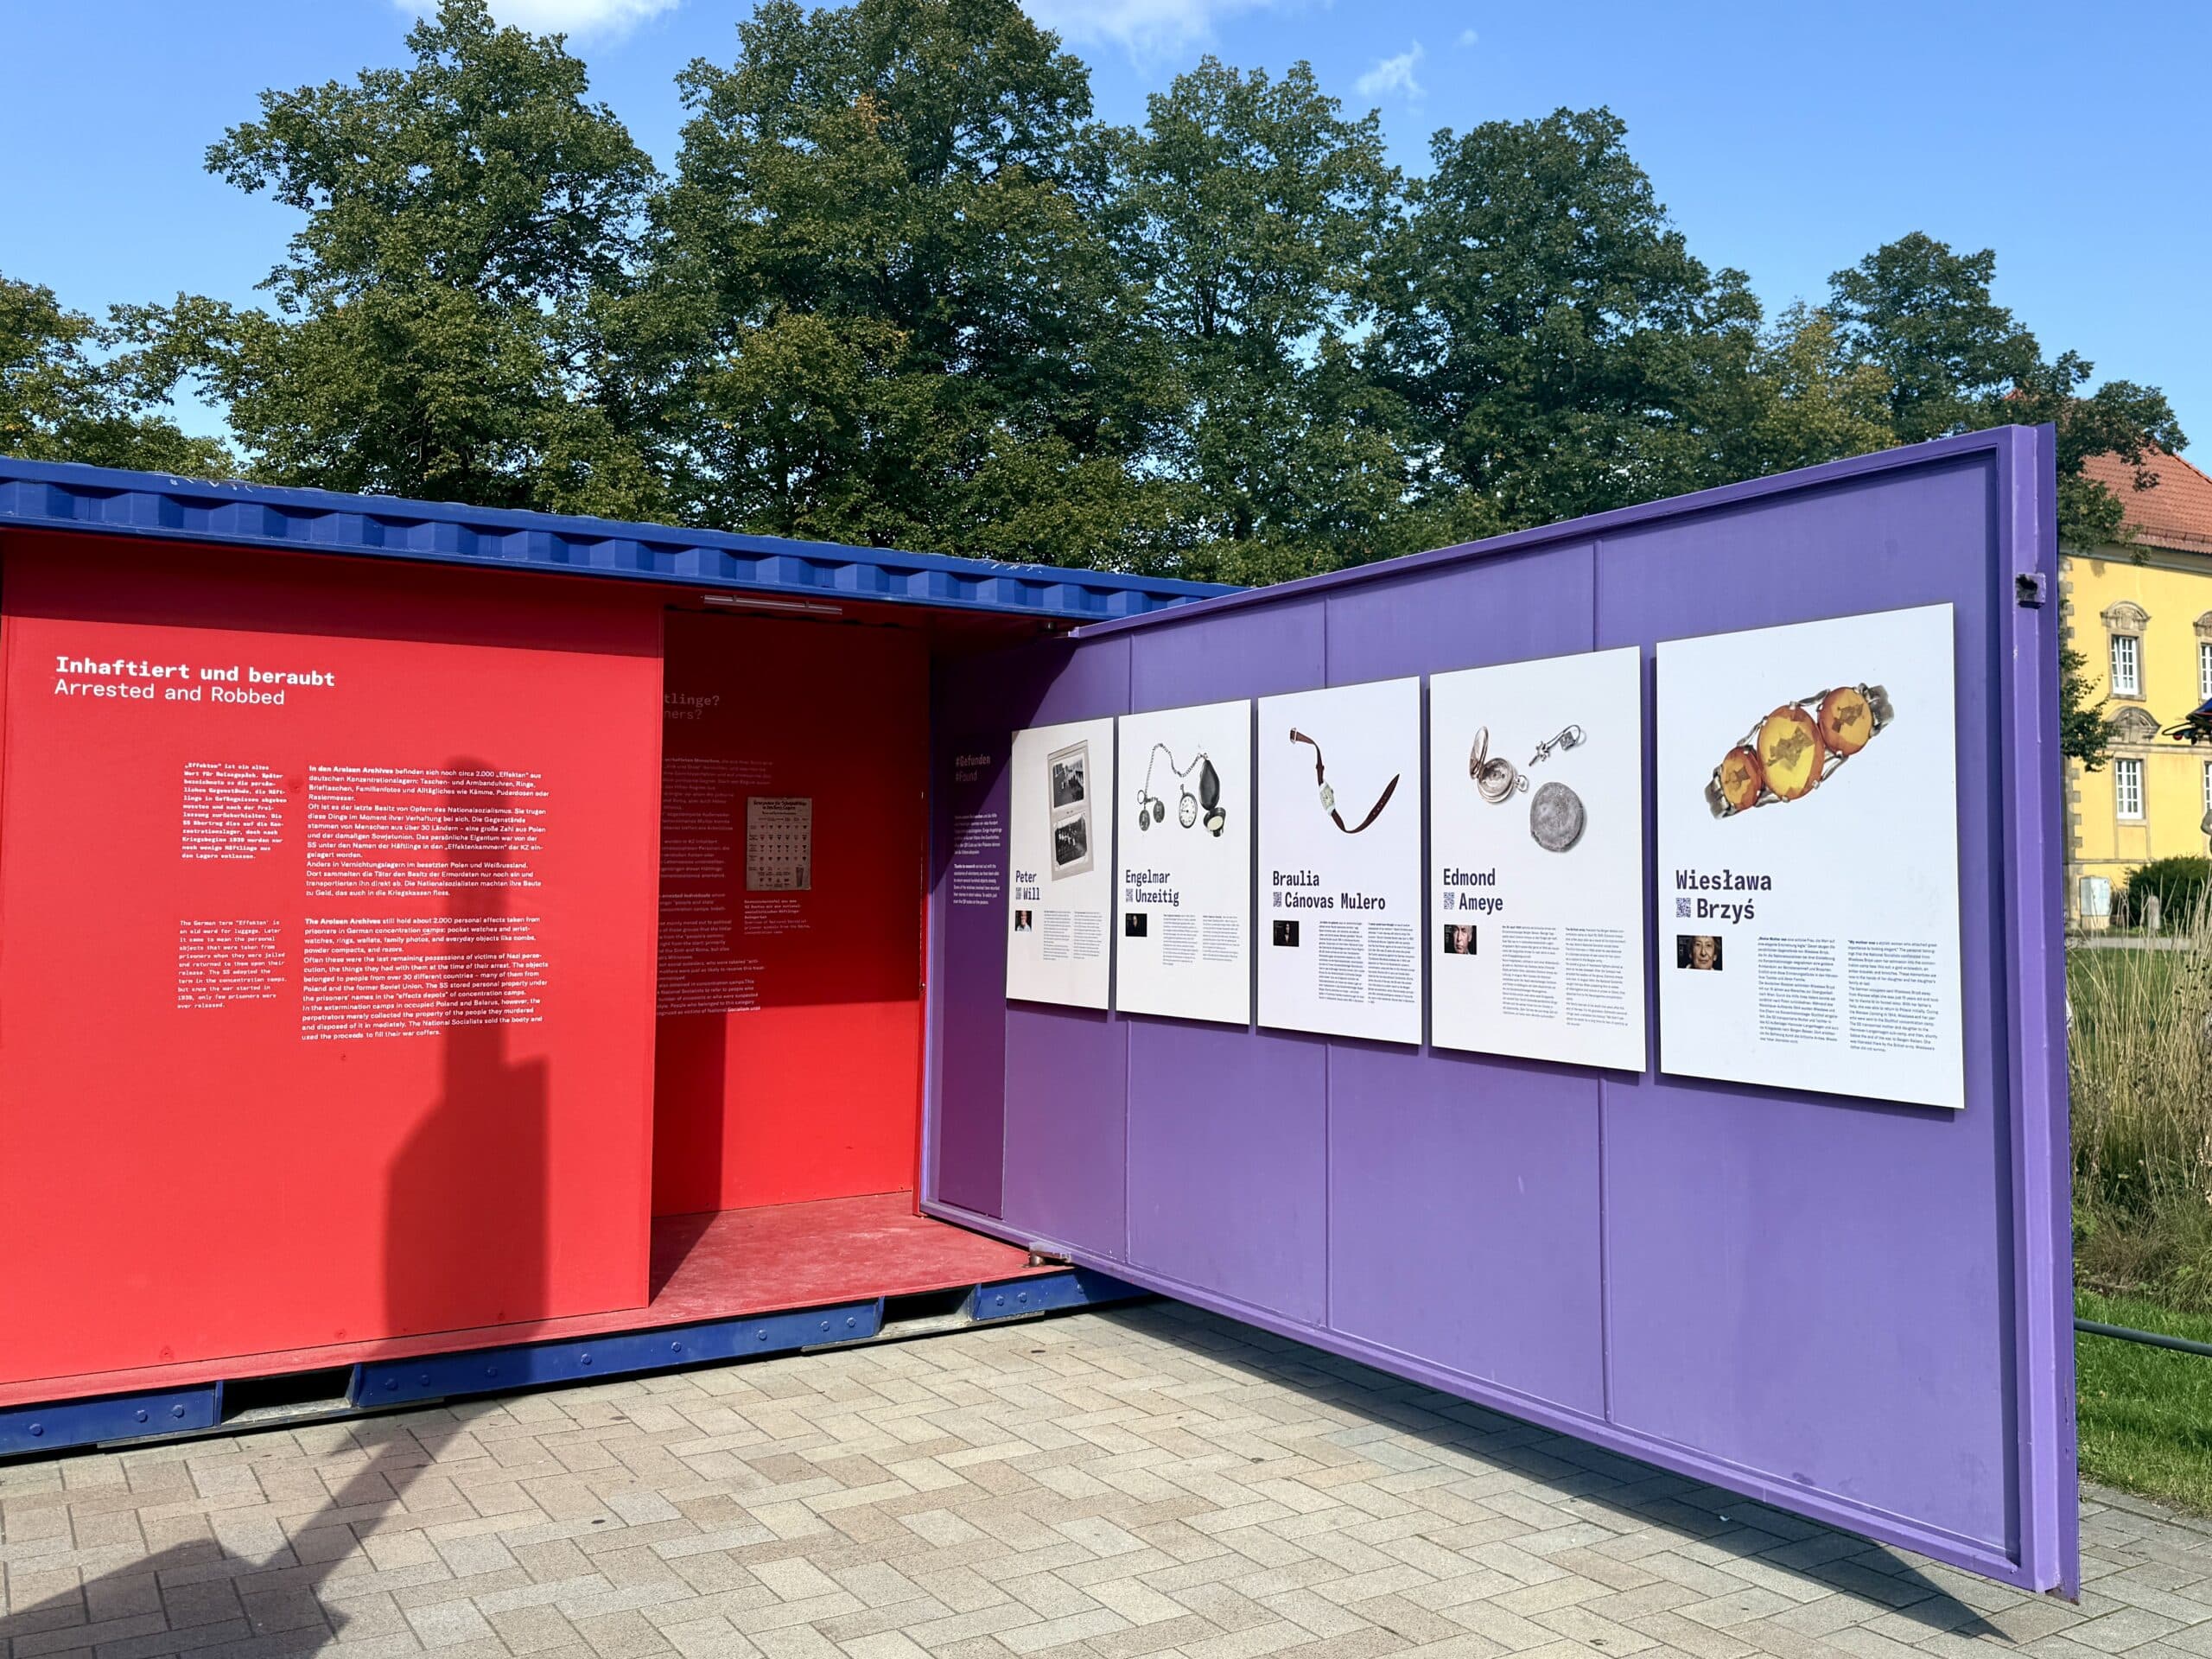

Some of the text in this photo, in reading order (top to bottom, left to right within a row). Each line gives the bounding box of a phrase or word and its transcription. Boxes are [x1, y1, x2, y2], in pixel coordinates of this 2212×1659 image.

[55, 656, 335, 687] Inhaftiert und beraubt
[54, 678, 285, 705] Arrested and Robbed
[1015, 869, 1037, 883] Peter
[1125, 868, 1171, 887] Engelmar
[1273, 869, 1319, 887] Braulia
[1443, 868, 1496, 887] Edmond
[1675, 868, 1772, 891] Wiesława
[1023, 887, 1040, 900] Will
[1135, 889, 1179, 907] Unzeitig
[1284, 891, 1386, 911] Cánovas Mulero
[1459, 892, 1503, 915] Ameye
[1697, 898, 1755, 924] Brzyś
